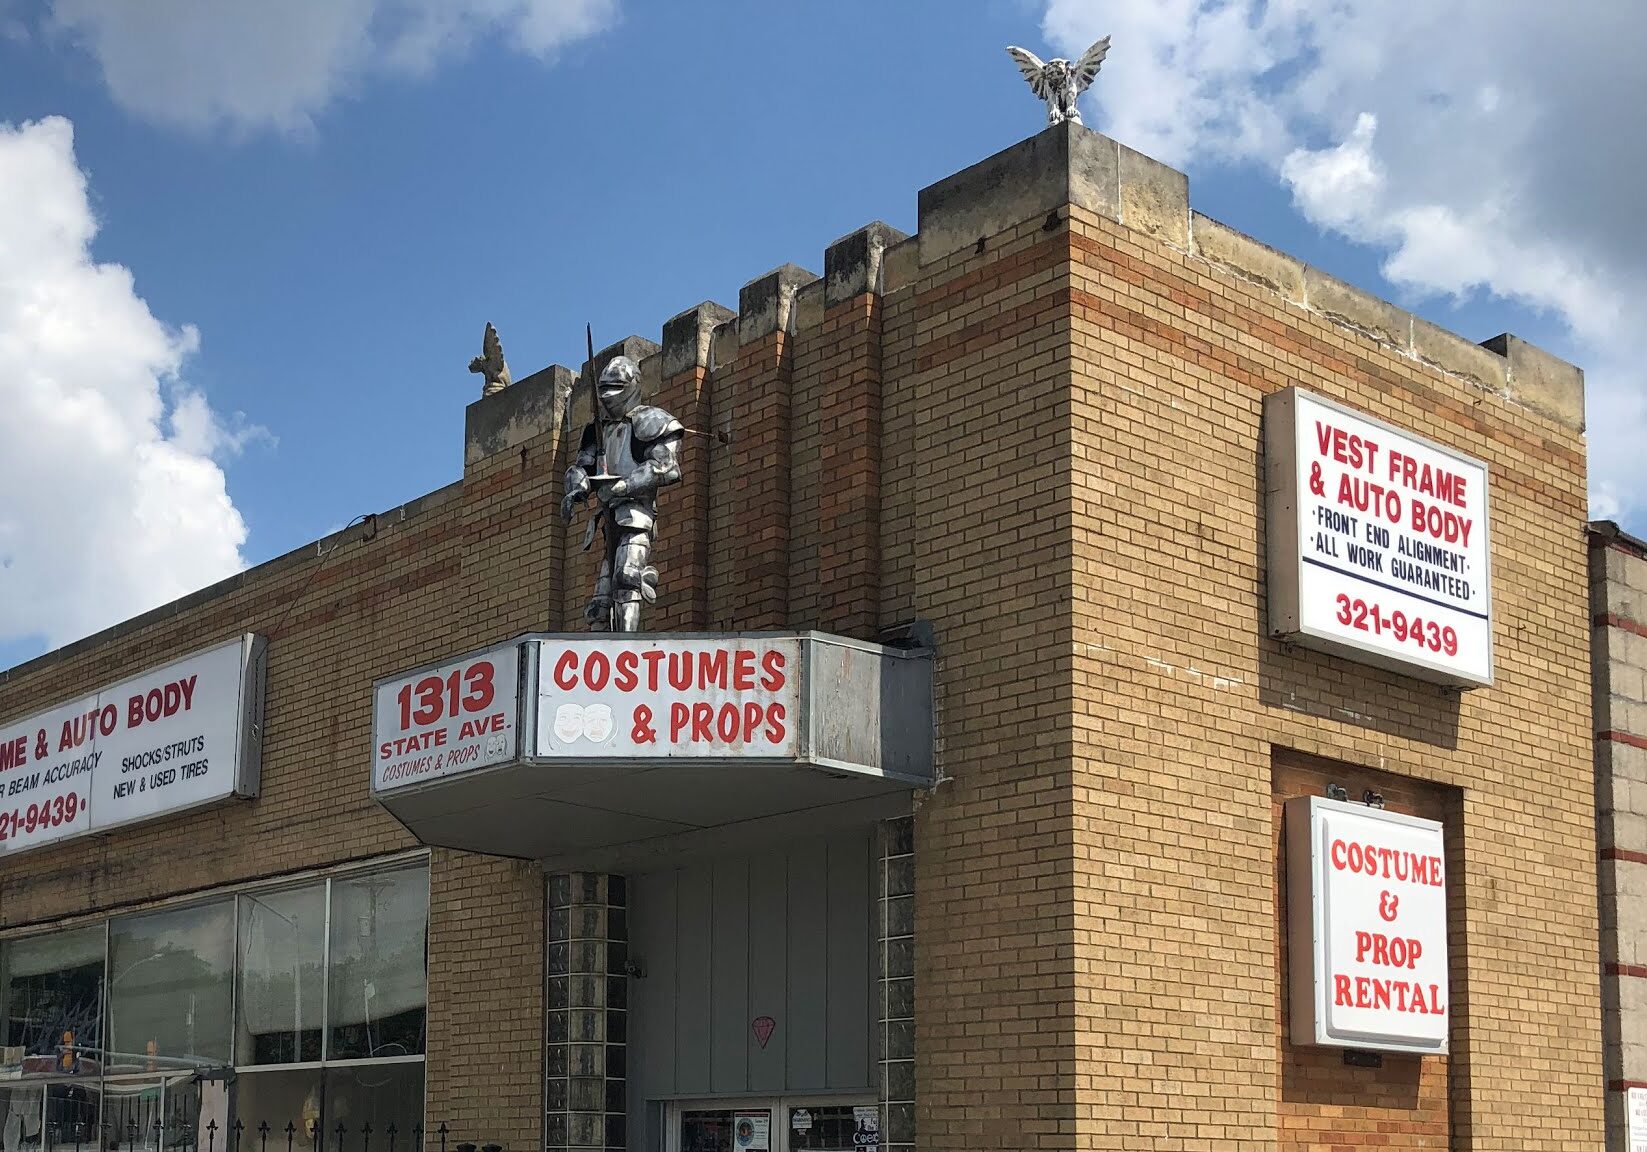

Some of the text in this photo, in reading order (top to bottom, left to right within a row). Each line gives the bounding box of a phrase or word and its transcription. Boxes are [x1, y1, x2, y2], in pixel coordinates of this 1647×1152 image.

[1315, 420, 1467, 509] VEST FRAME
[1309, 460, 1473, 548] & AUTO BODY
[1366, 523, 1390, 549] END
[1347, 542, 1383, 573] WORK
[1335, 593, 1458, 657] 321-9439
[553, 649, 786, 692] COSTUMES
[397, 661, 495, 731] 1313
[34, 728, 49, 761] &
[58, 703, 118, 752] AUTO
[127, 674, 198, 729] BODY
[380, 712, 512, 760] STATE AVE.
[630, 702, 786, 744] & PROPS
[8, 772, 40, 797] BEAM
[42, 751, 103, 786] ACCURACY
[121, 735, 205, 774] SHOCKS/STRUTS
[382, 744, 480, 782] COSTUMES & PROPS
[113, 759, 209, 800] NEW & USED TIRES
[1331, 839, 1443, 887] COSTUME
[1379, 890, 1399, 922] &
[1355, 931, 1422, 969] PROP
[1334, 974, 1445, 1015] RENTAL
